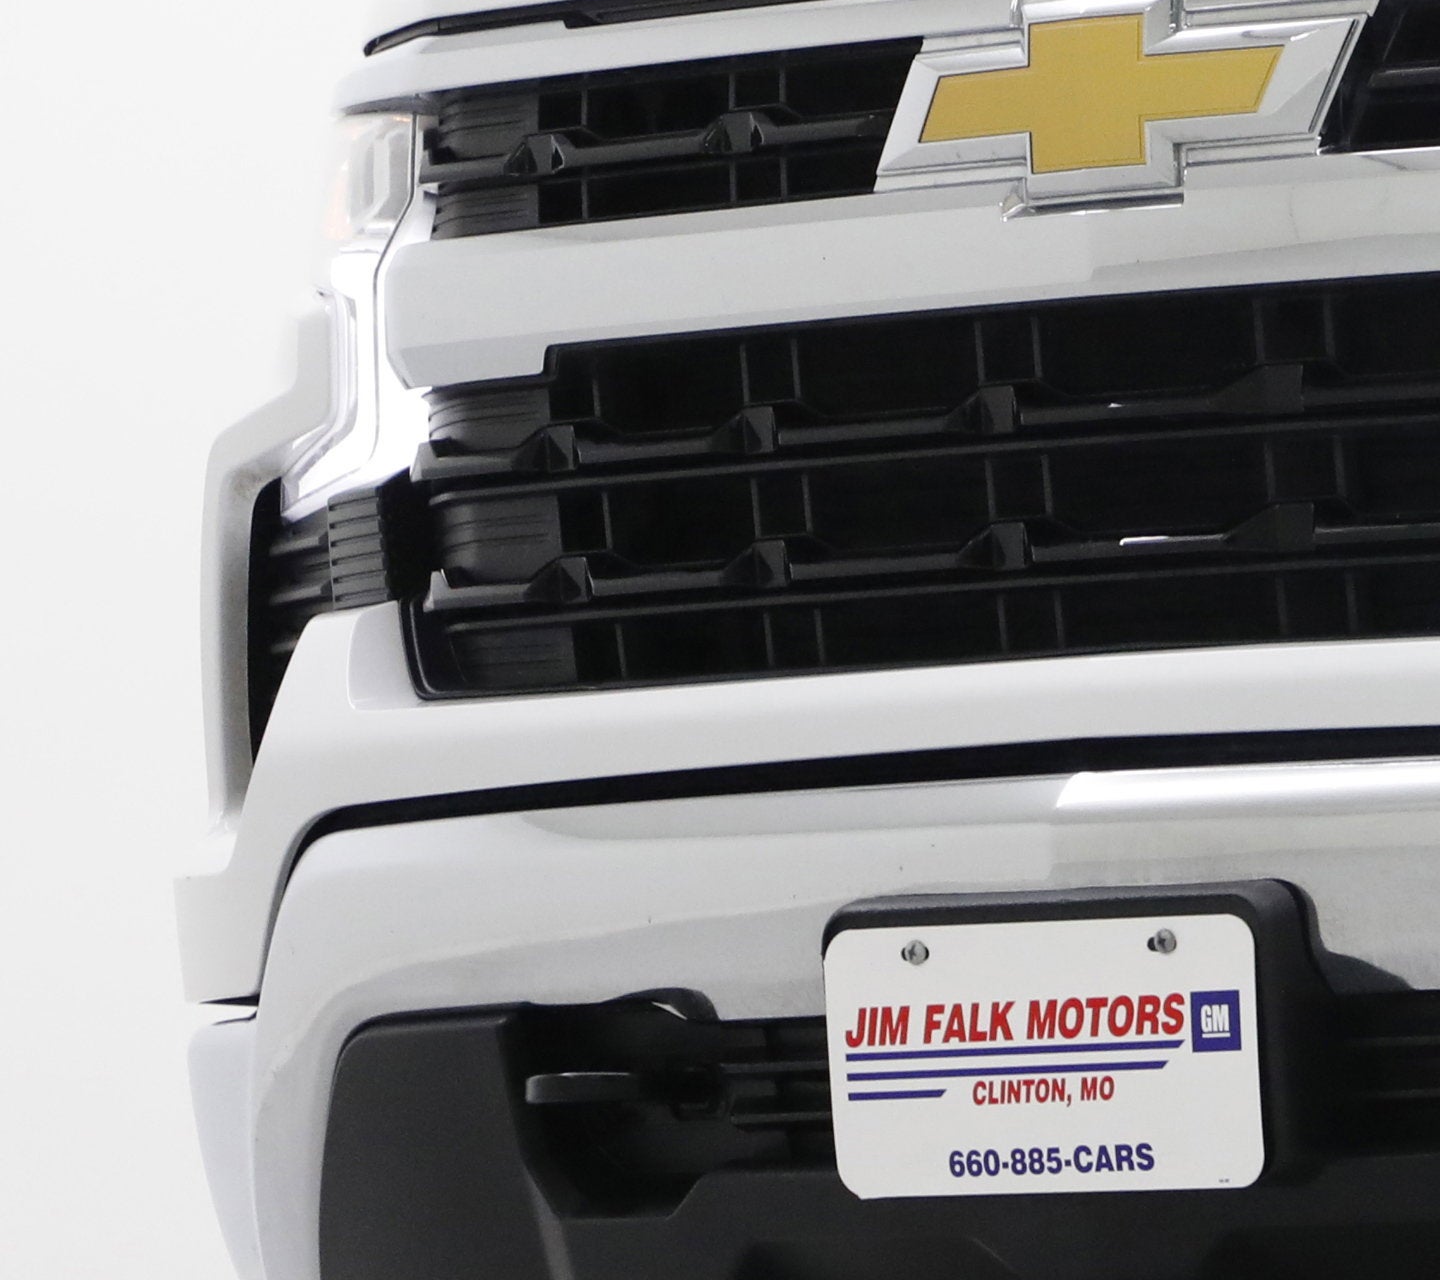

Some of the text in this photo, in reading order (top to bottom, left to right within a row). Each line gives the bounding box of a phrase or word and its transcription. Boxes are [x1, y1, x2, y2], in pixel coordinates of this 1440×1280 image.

[846, 993, 1186, 1048] JIM FALK MOTORS
[1200, 1004, 1231, 1034] GM
[972, 1076, 1115, 1107] CLINTON, MO
[949, 1143, 1155, 1178] 660-885-CARS
